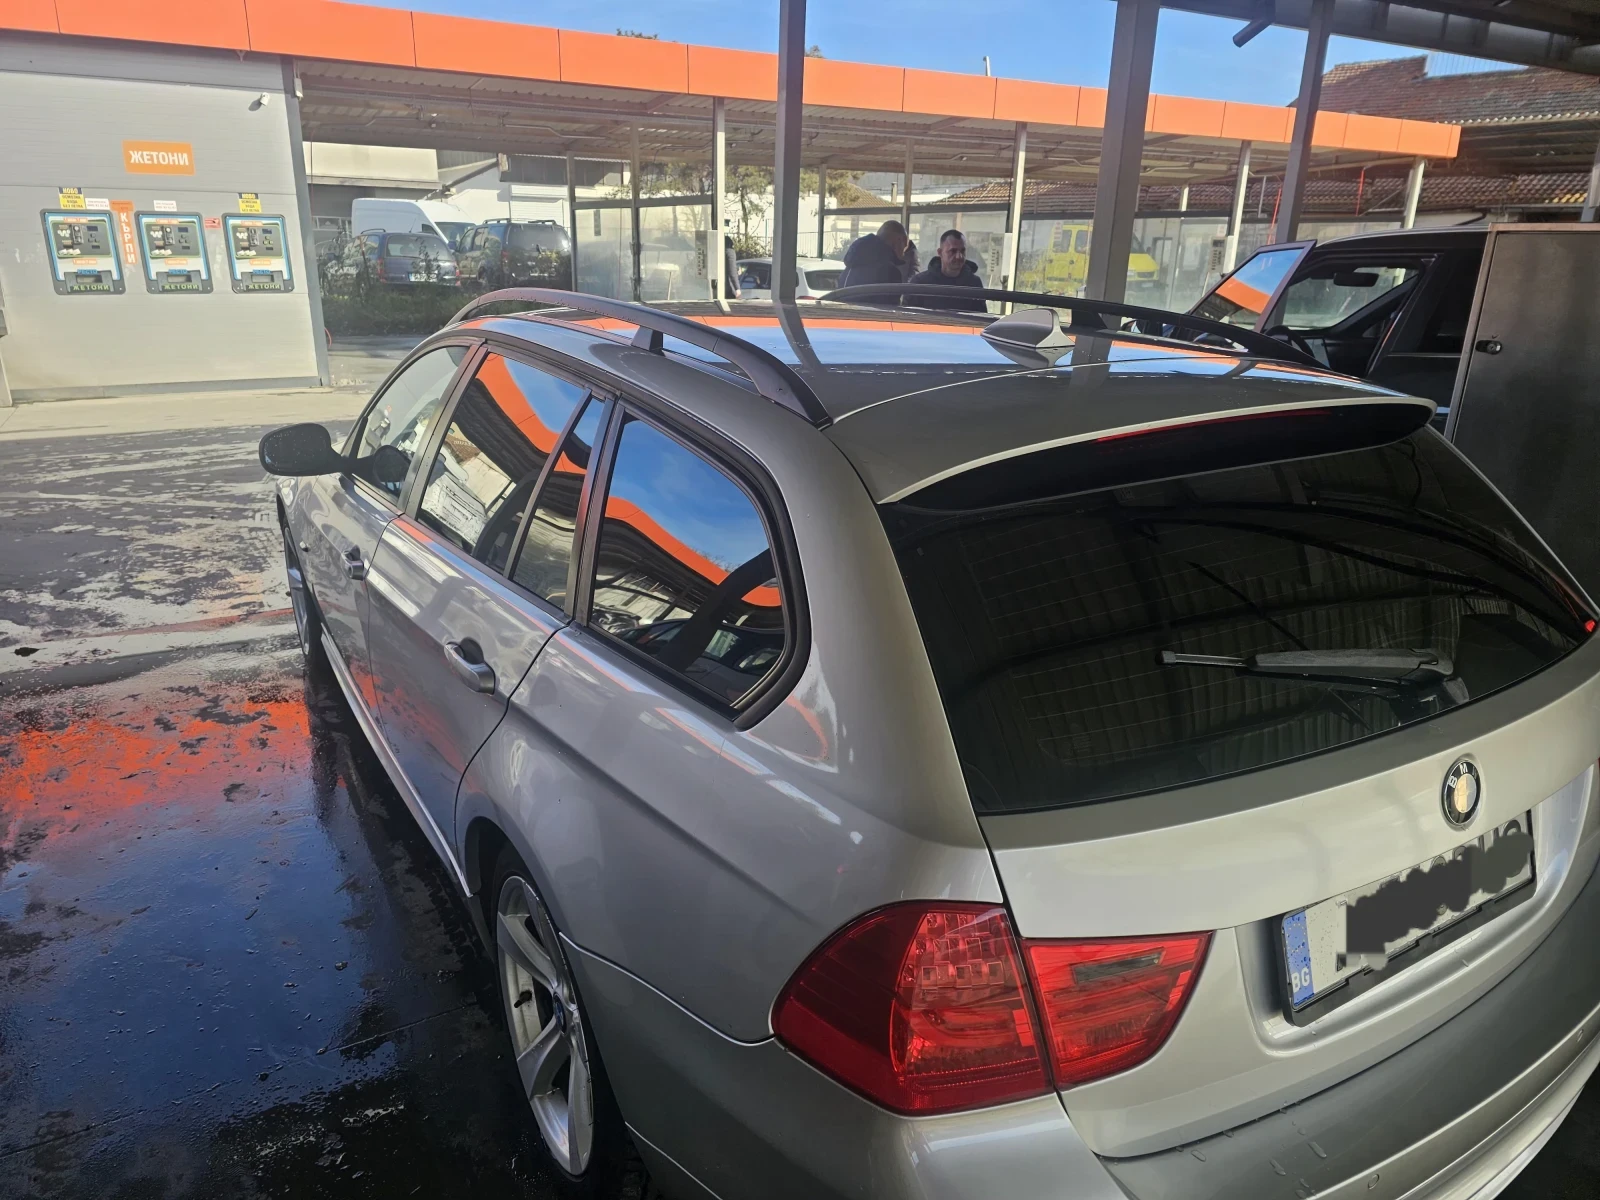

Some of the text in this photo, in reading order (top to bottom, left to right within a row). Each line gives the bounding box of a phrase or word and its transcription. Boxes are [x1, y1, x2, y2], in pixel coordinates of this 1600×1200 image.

[128, 150, 189, 166] ЖЕТОНИ
[120, 212, 136, 263] КЪРПИ
[1447, 762, 1477, 789] BMW
[1291, 967, 1310, 993] BG
